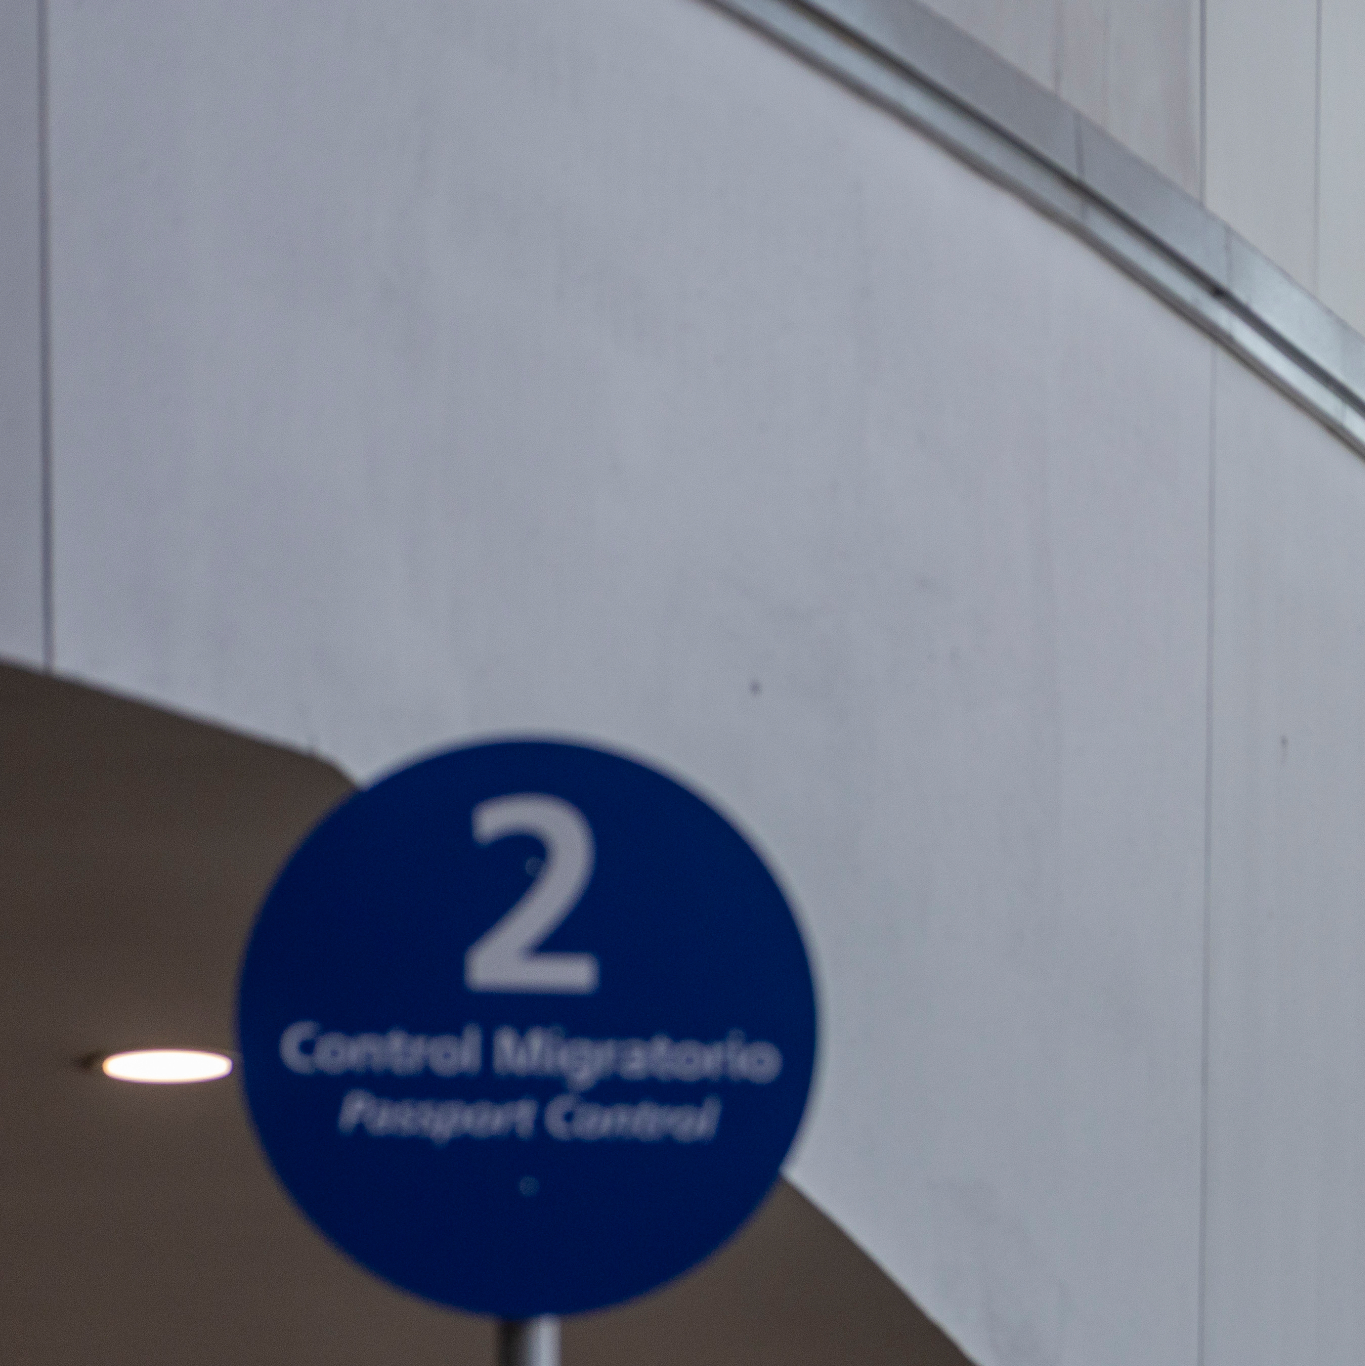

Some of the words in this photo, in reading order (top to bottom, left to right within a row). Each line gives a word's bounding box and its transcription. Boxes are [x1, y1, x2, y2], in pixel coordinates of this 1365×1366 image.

[466, 793, 598, 992] 2
[280, 1021, 481, 1075] Control
[494, 1026, 782, 1090] Migratorio
[338, 1090, 537, 1146] Passport
[543, 1094, 721, 1142] Control
